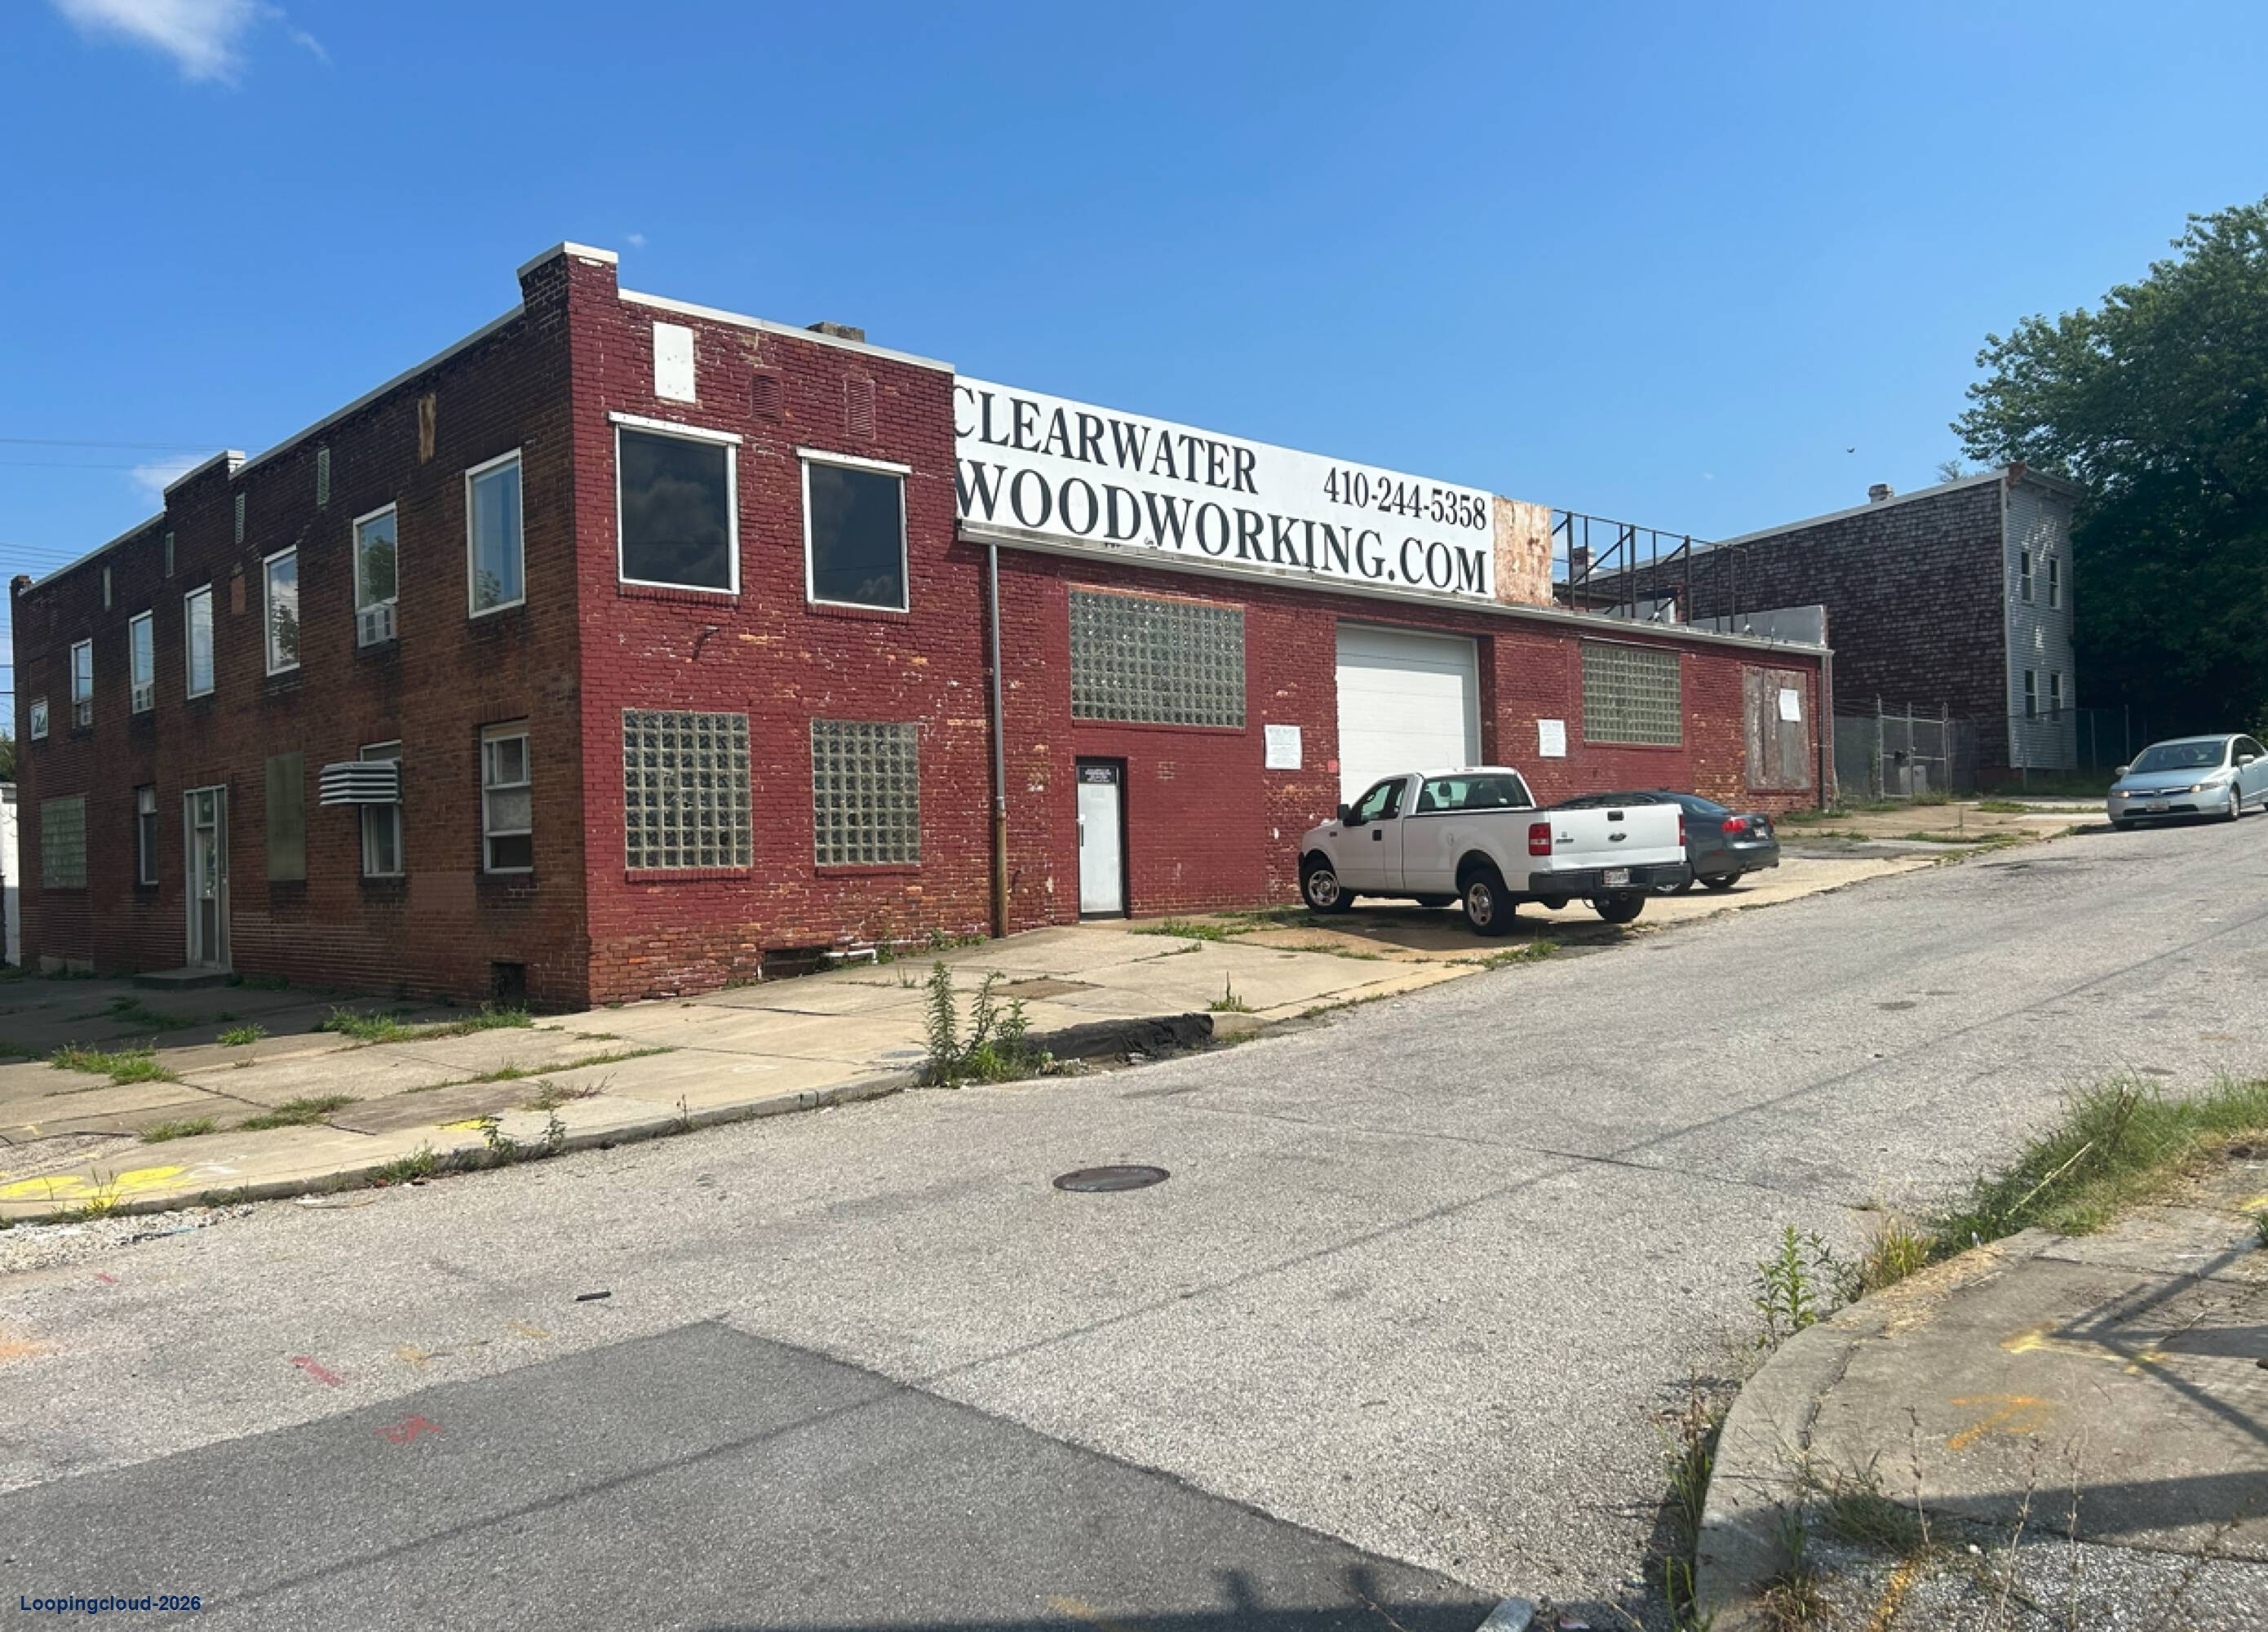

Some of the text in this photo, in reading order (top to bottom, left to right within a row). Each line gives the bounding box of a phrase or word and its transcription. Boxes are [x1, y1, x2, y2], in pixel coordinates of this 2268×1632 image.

[955, 384, 1259, 495] CLEARWATER
[955, 458, 1487, 594] WOODWORKING.COM
[1323, 467, 1486, 530] 410-244-5358
